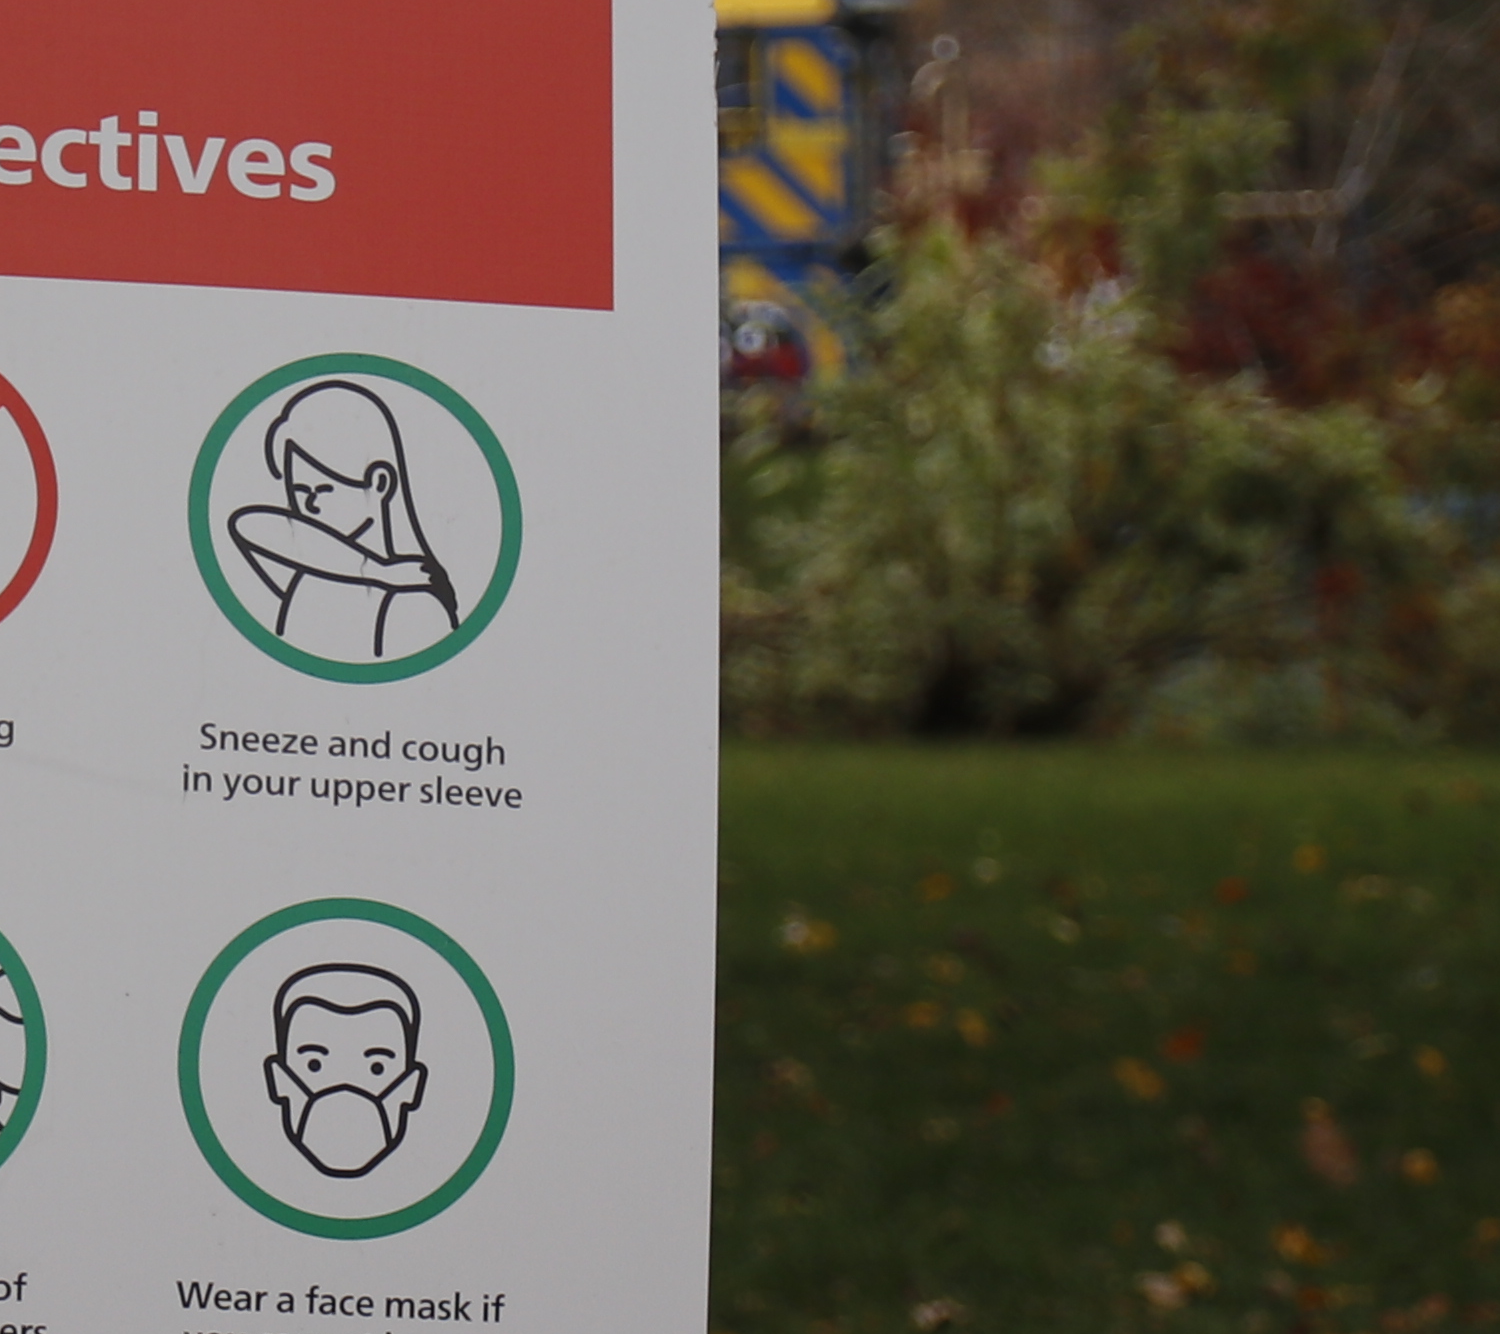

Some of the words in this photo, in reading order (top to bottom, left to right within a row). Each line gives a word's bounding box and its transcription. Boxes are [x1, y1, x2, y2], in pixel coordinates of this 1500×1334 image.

[199, 721, 319, 757] Sneeze
[327, 729, 392, 760] and
[401, 735, 506, 773] cough
[182, 762, 213, 793] in
[222, 772, 302, 802] your
[310, 776, 412, 809] upper
[419, 774, 524, 810] sleeve
[175, 1280, 269, 1313] Wear
[275, 1291, 296, 1314] a
[304, 1284, 375, 1318] face
[384, 1290, 472, 1323] mask
[481, 1292, 506, 1324] if
